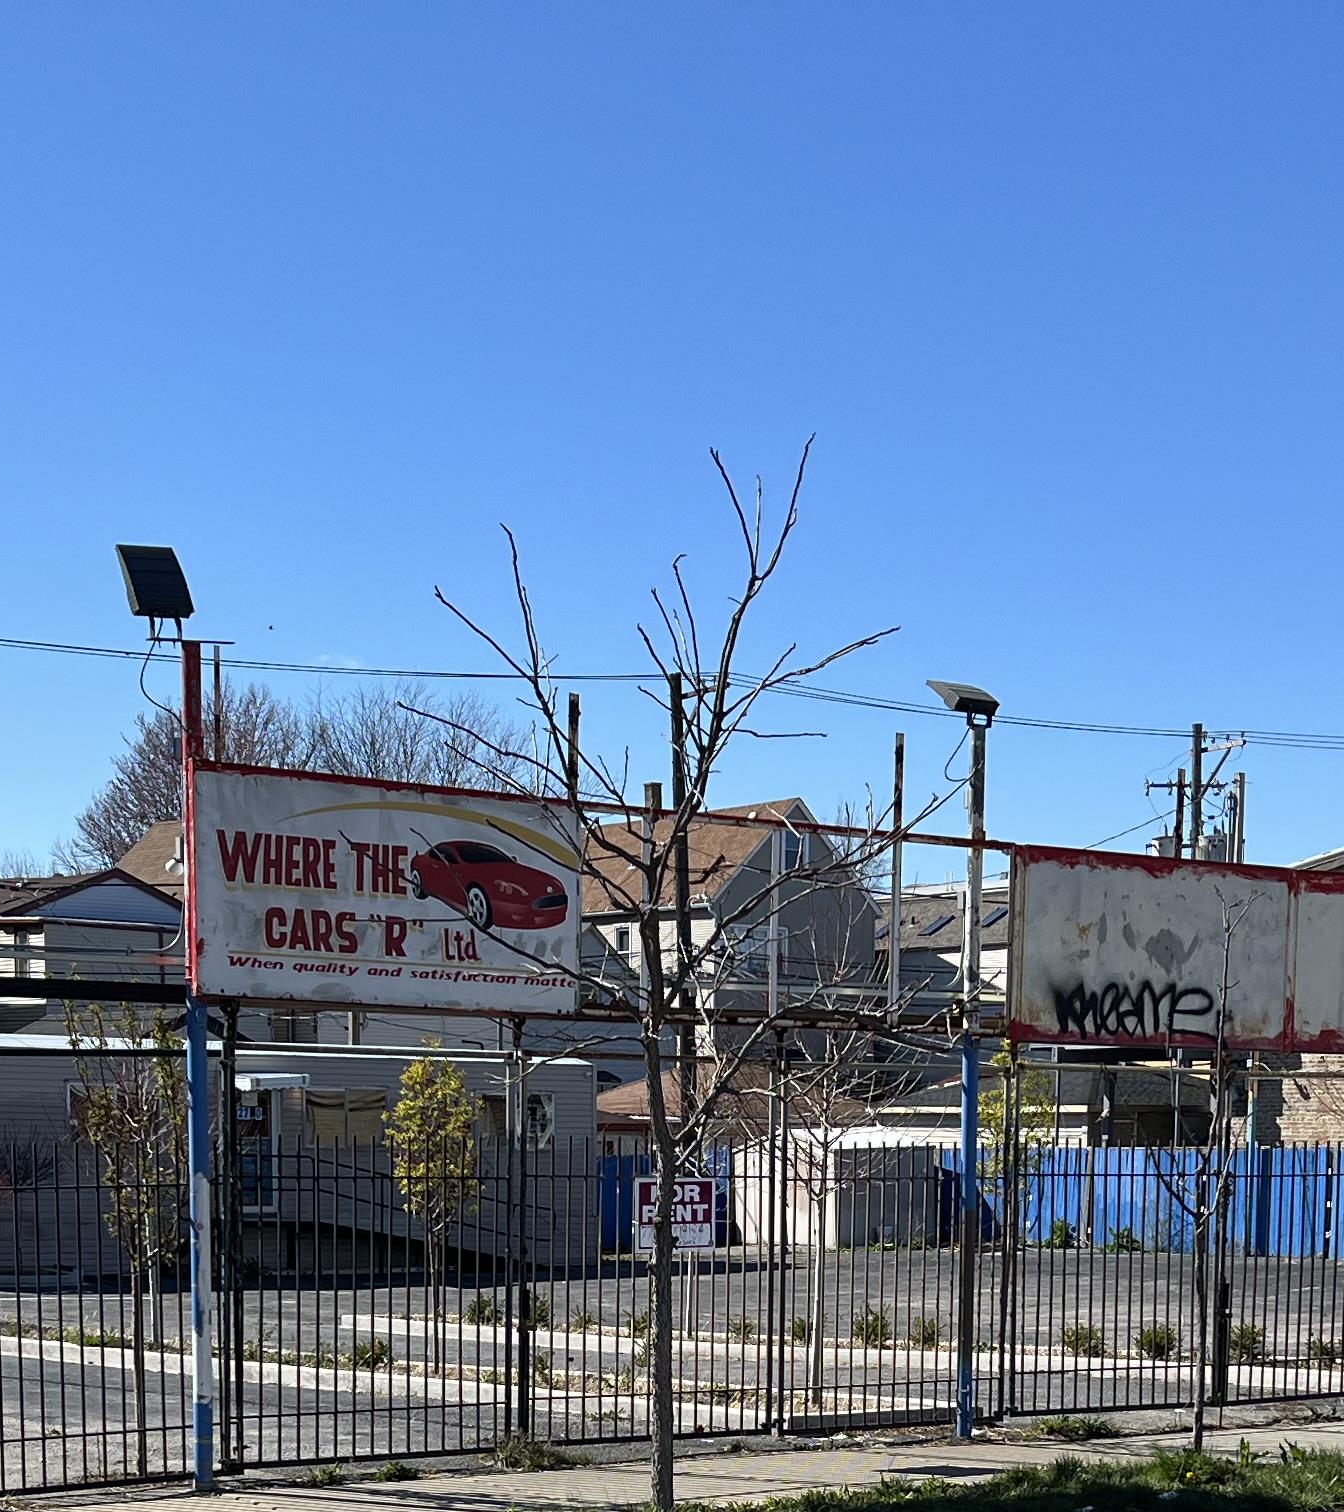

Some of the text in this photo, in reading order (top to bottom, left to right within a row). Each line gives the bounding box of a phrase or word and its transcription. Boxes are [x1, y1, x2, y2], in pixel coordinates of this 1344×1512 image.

[216, 829, 409, 896] WHERE THE
[264, 906, 359, 954] CARS
[443, 927, 481, 962] Ltd
[227, 955, 284, 970] When
[292, 960, 359, 977] quality
[367, 966, 403, 978] and
[642, 1204, 709, 1223] RNT
